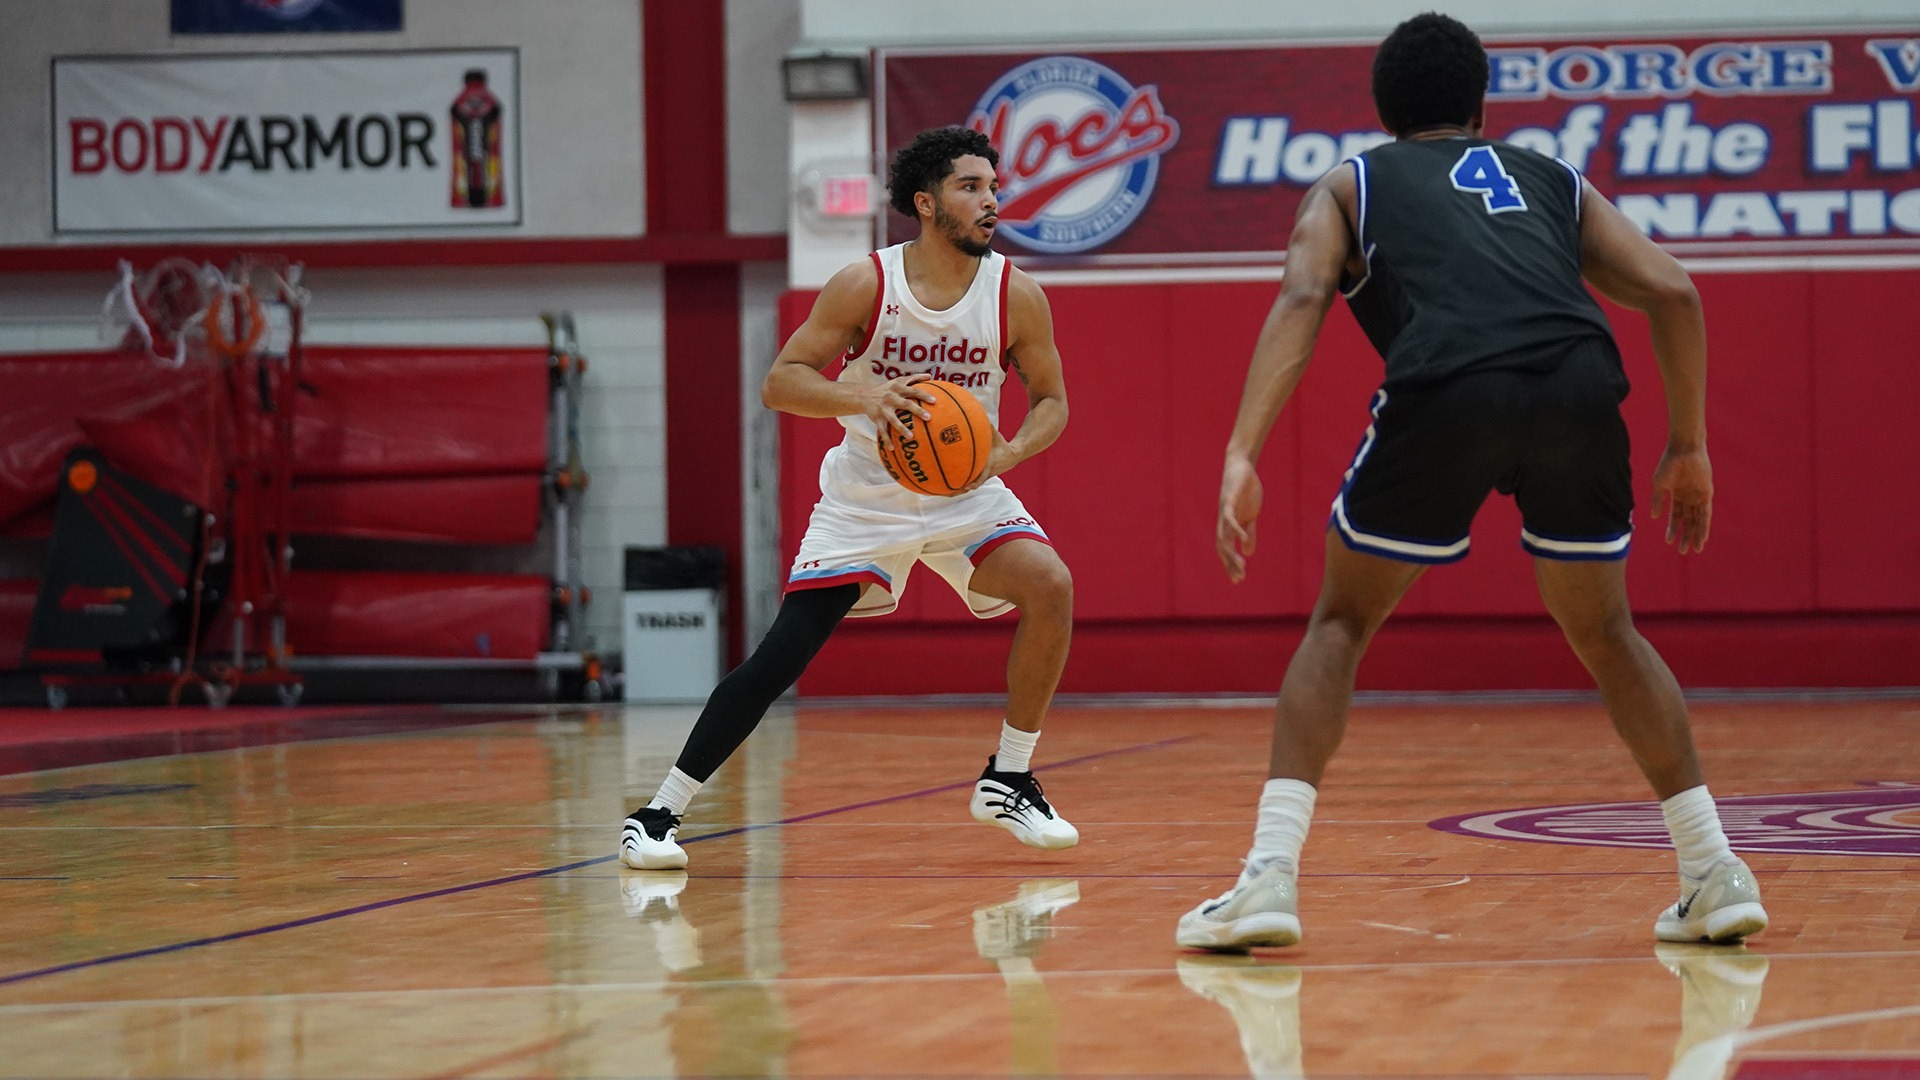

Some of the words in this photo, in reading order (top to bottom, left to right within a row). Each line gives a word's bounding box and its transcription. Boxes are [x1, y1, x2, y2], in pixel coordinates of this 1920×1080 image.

[1015, 64, 1100, 91] FLORIDA
[1488, 41, 1832, 97] EORGE
[69, 114, 438, 173] BODYARMOR
[1214, 117, 1397, 183] Ho
[1504, 104, 1604, 172] of
[1621, 102, 1768, 173] the
[1812, 100, 1920, 171] Fl
[1449, 146, 1528, 214] 4
[1039, 190, 1137, 243] SOUTHERN
[871, 360, 990, 388] Sohern
[882, 336, 989, 365] Florida
[895, 409, 928, 482] Wlson
[637, 612, 704, 628] TRASH
